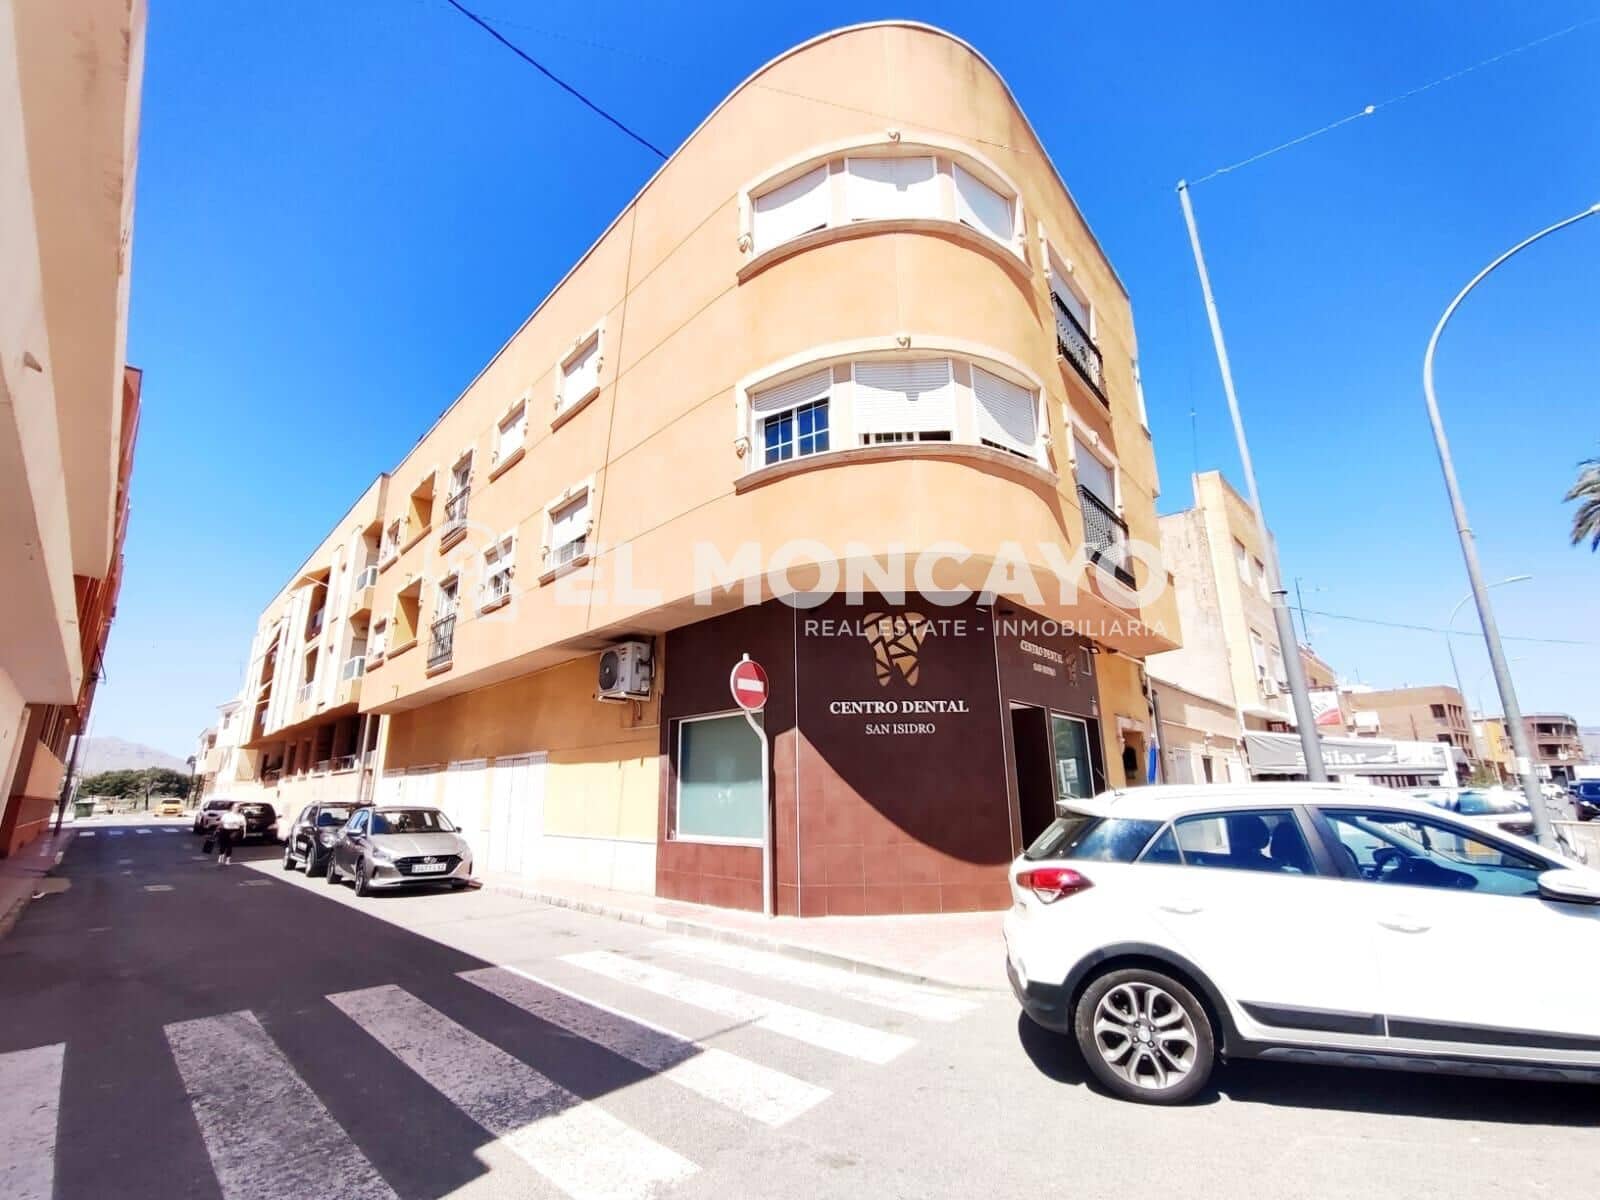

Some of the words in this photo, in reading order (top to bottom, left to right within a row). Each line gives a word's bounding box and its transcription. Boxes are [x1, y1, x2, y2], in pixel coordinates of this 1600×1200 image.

[829, 701, 898, 714] CENTRO
[902, 700, 969, 713] DENTAL
[865, 724, 890, 735] SAN
[893, 723, 936, 735] ISIDRO
